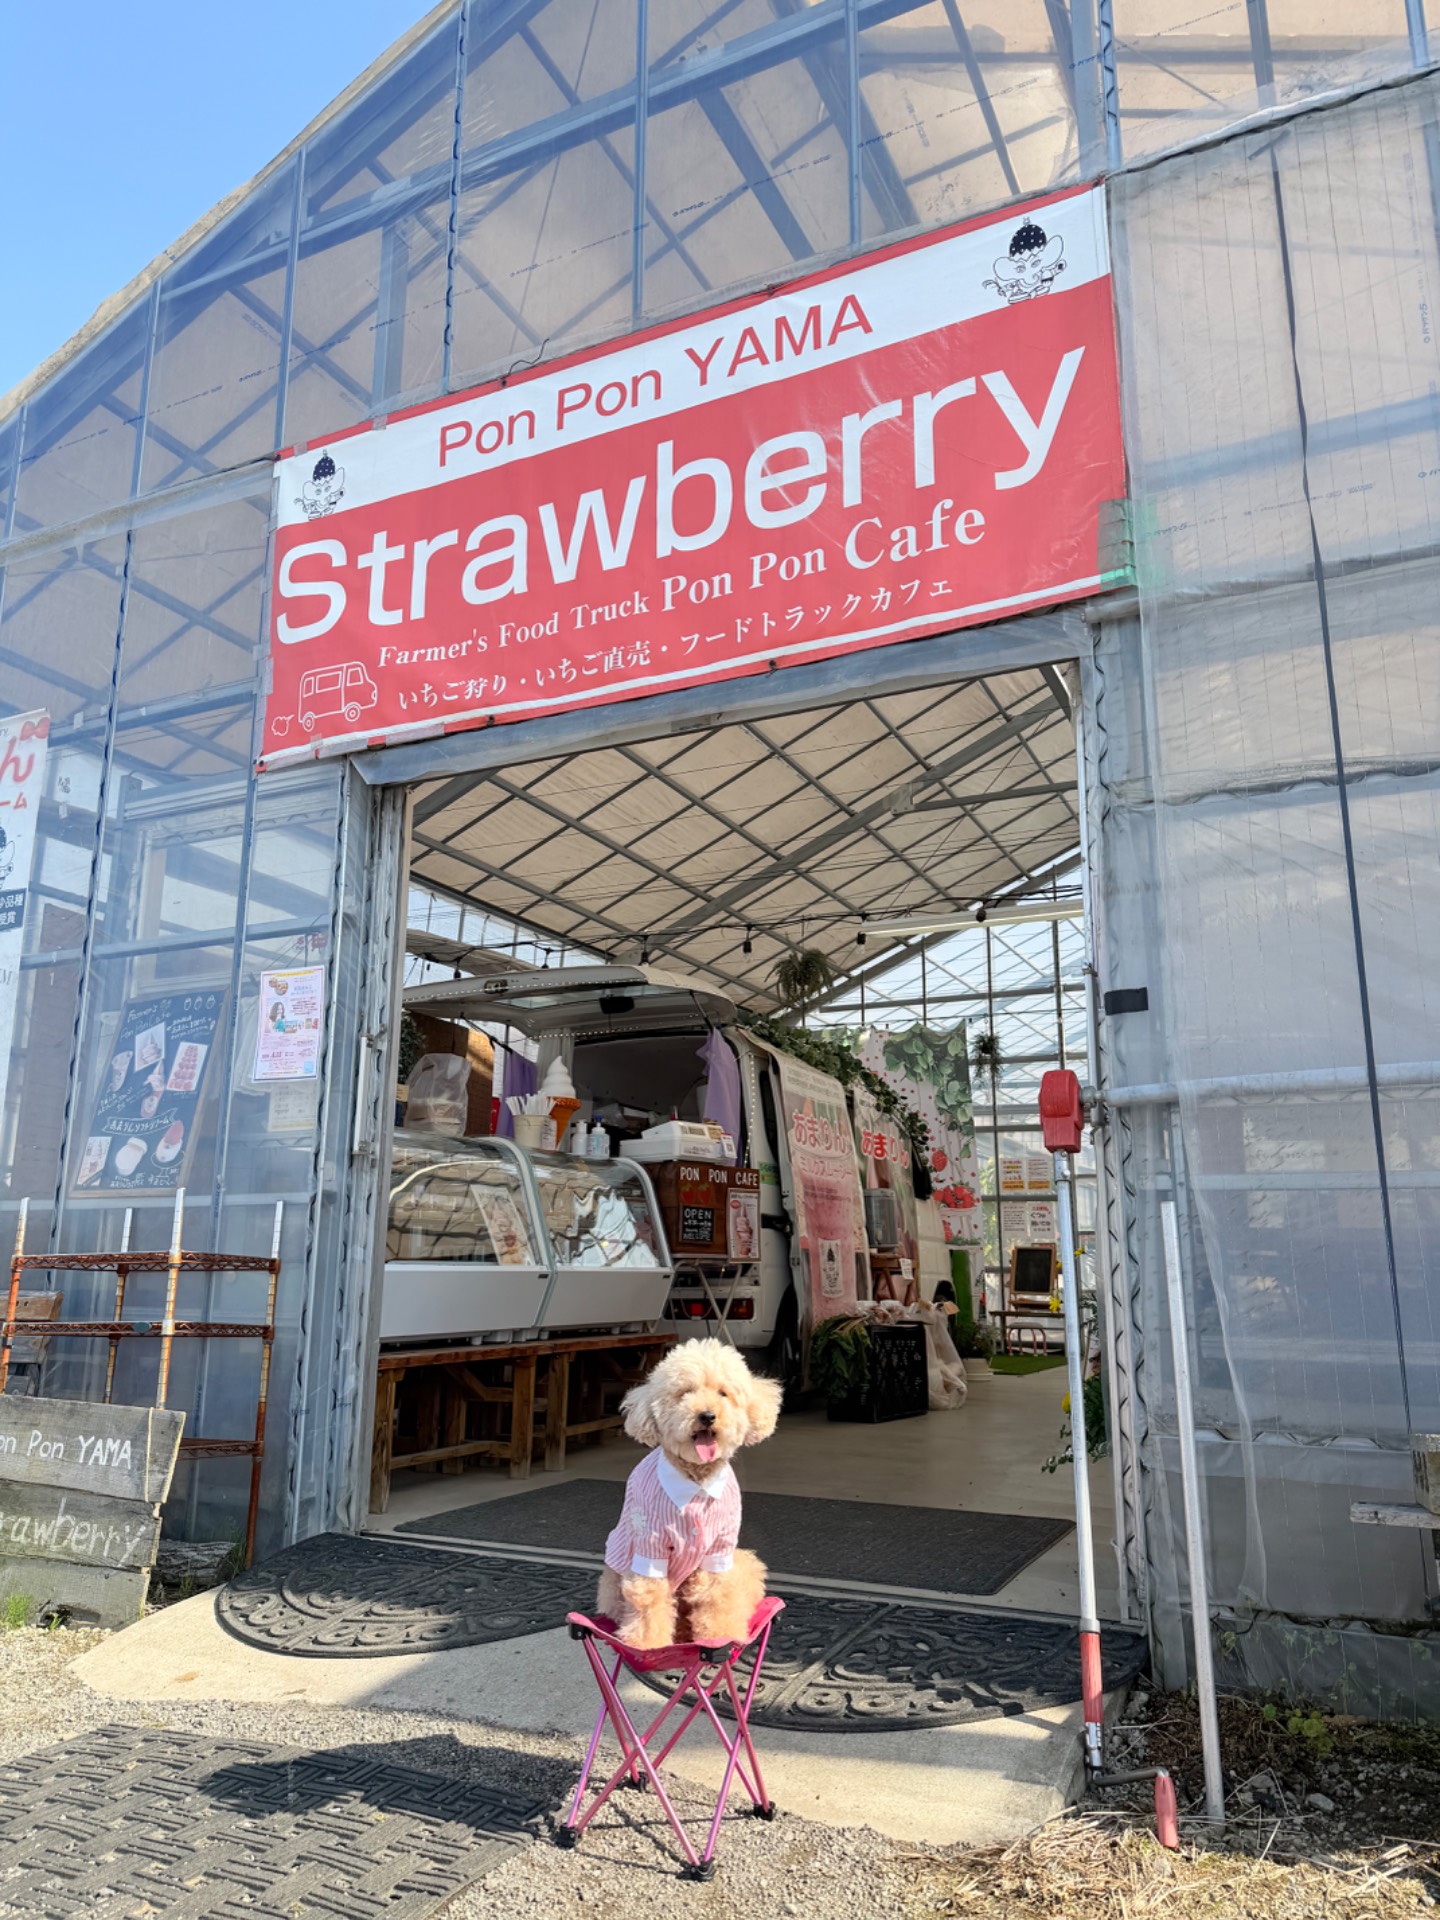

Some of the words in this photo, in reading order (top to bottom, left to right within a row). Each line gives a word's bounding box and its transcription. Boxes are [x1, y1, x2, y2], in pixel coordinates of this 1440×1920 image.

[439, 411, 536, 467] Pon
[556, 369, 663, 431] Pon
[684, 294, 874, 387] YAMA
[275, 346, 1086, 645] Strawberry
[378, 628, 490, 668] Farmer's
[497, 611, 560, 648] Food
[571, 591, 650, 629] Truck
[661, 571, 732, 613] Pon
[750, 547, 827, 588] Pon
[844, 498, 986, 570] Cafe
[398, 579, 954, 711] いちご狩り・いちご直売・フードトラックカフェ
[792, 1111, 849, 1155] あまりん
[860, 1129, 910, 1169] あまりん
[679, 1166, 700, 1182] PON
[708, 1168, 728, 1184] PON
[735, 1172, 759, 1187] CAFE
[683, 1208, 712, 1220] OPEN
[26, 1429, 64, 1460] Pon
[78, 1434, 132, 1470] YAMA
